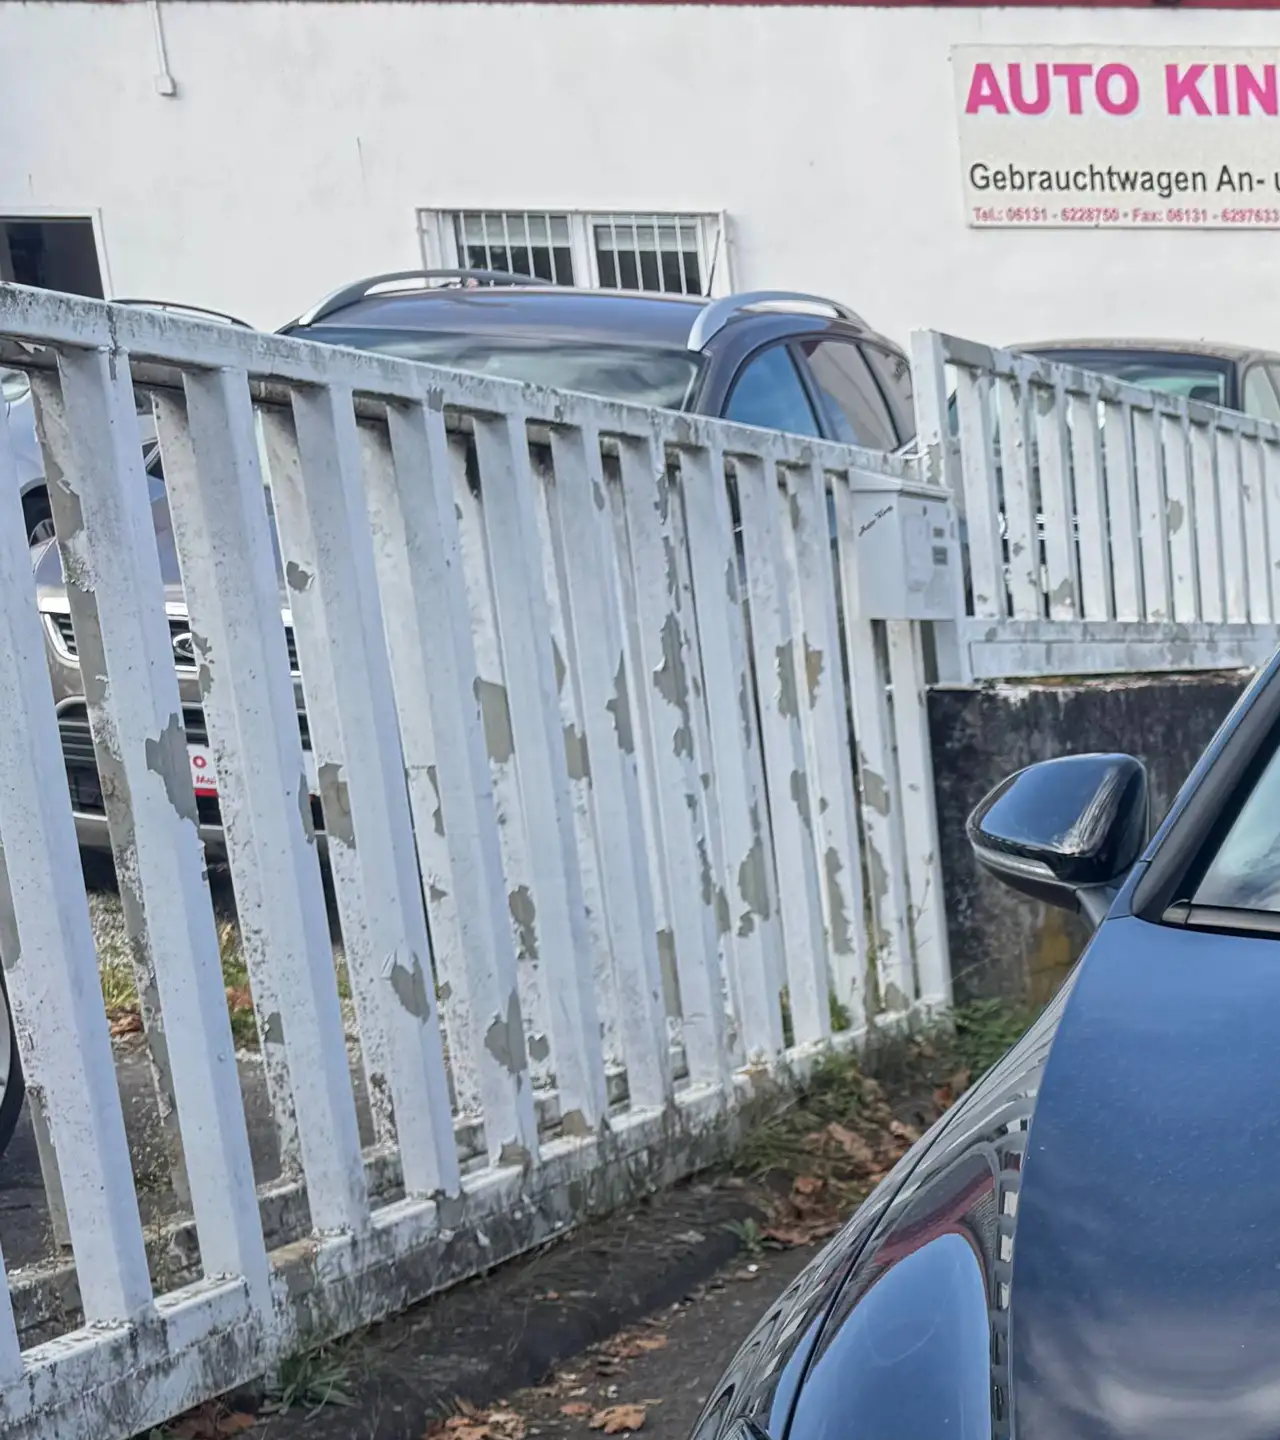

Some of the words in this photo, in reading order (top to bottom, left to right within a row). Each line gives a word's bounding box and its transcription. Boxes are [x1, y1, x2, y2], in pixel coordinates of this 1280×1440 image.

[965, 63, 1140, 116] AUTO
[970, 163, 1207, 198] Gebrauchtwagen
[1215, 164, 1265, 193] An-
